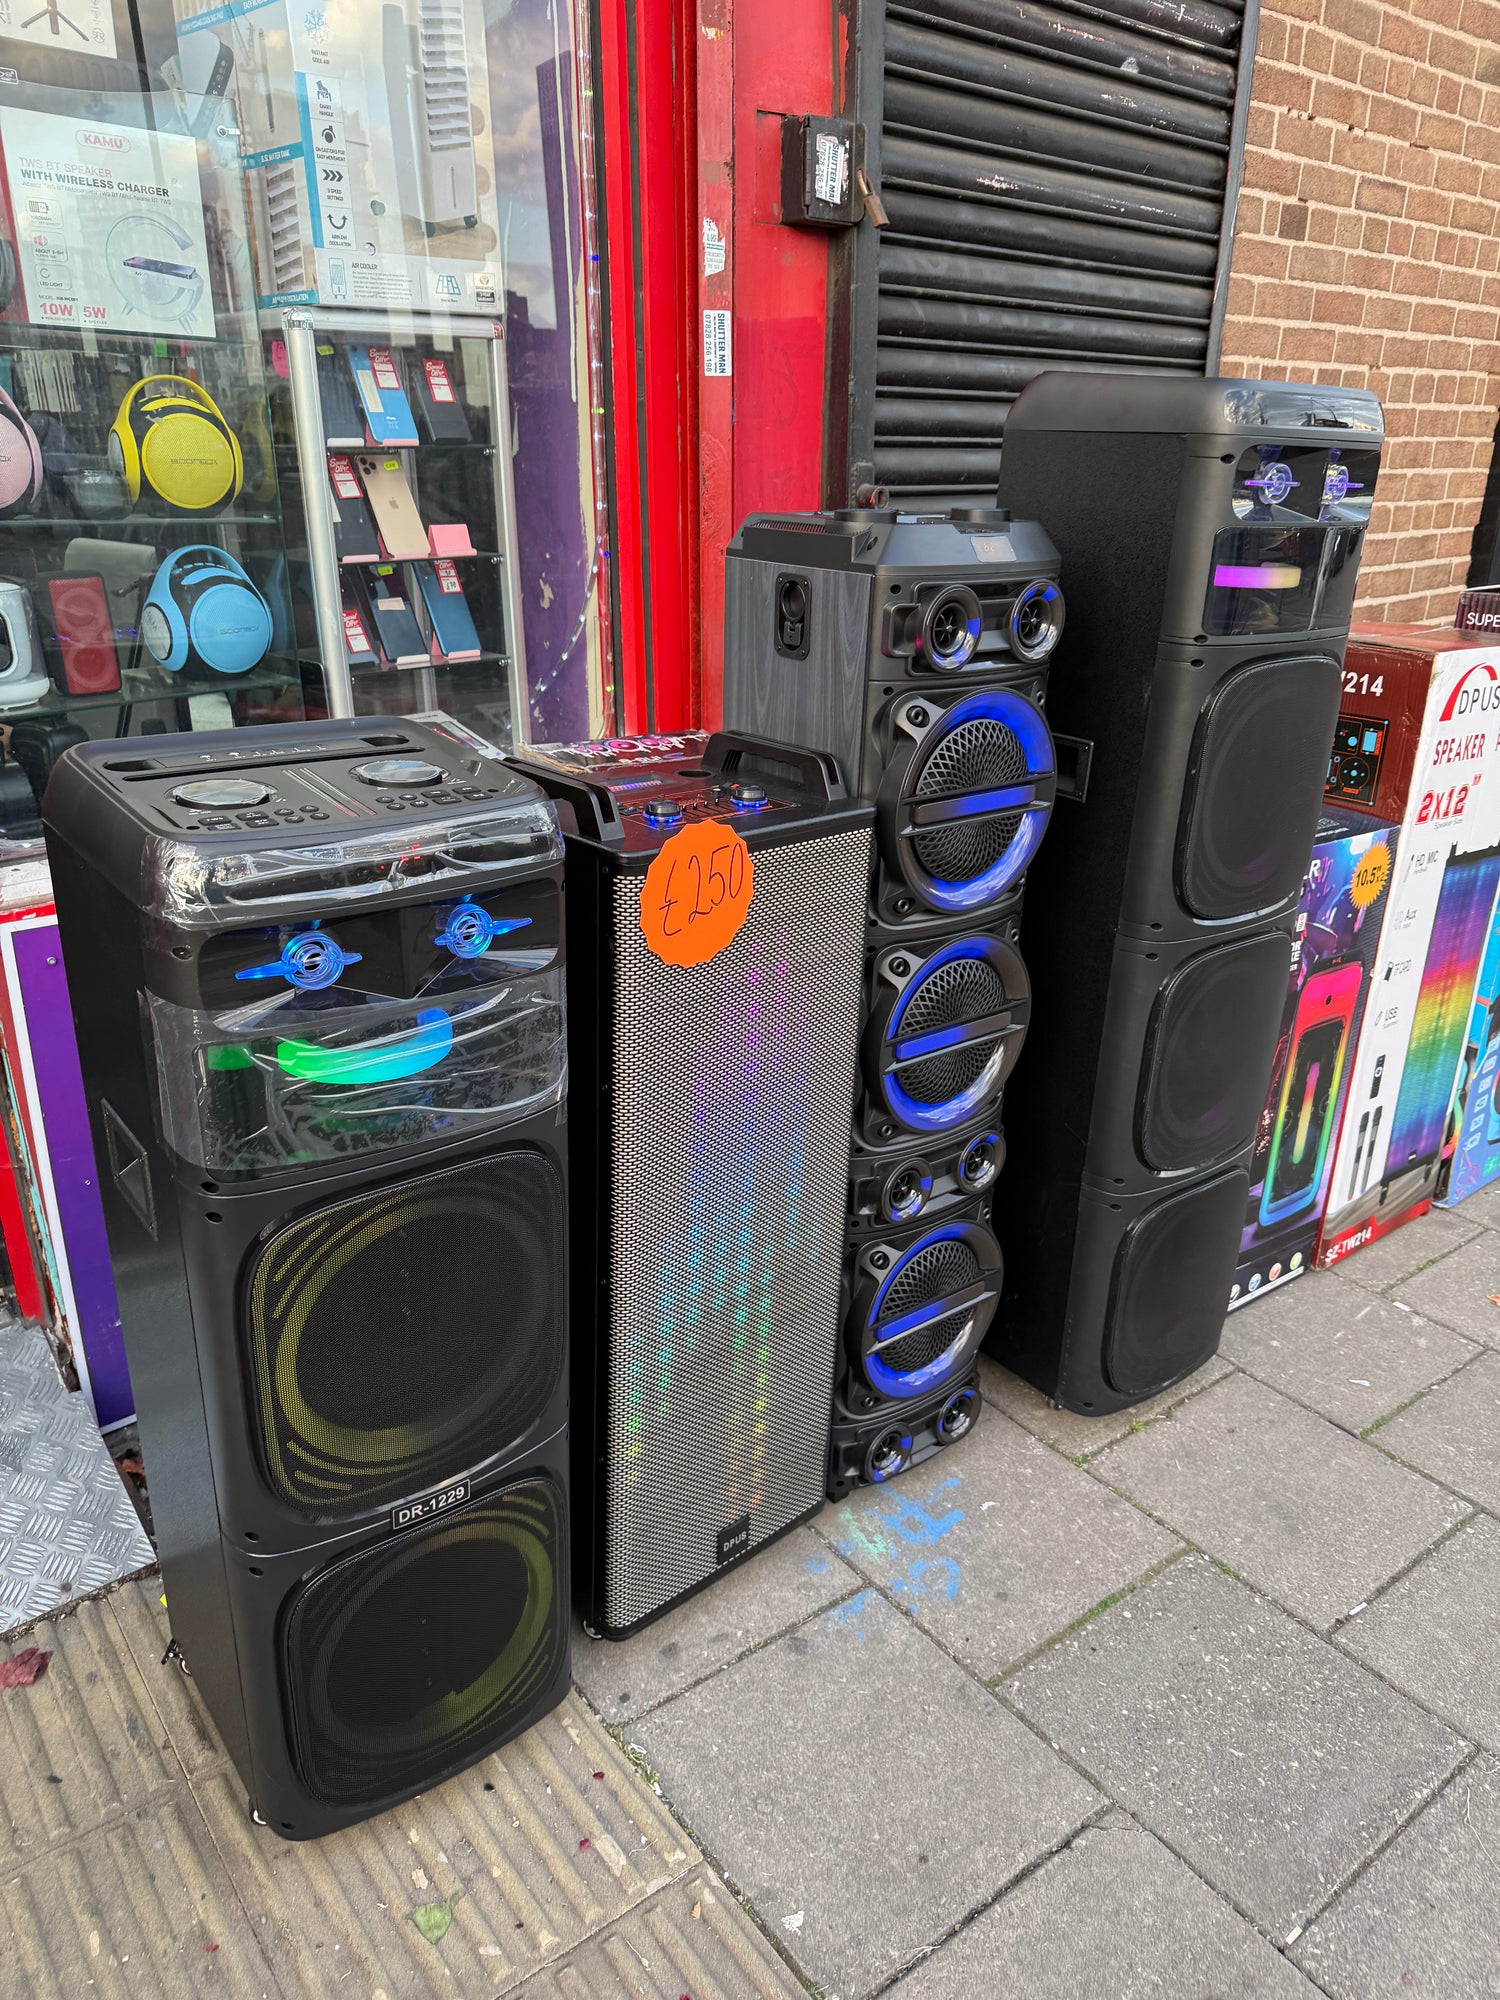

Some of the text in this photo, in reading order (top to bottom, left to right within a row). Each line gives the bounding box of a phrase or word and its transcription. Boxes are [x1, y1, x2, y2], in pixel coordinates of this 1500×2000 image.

[83, 133, 124, 149] KAMU
[819, 141, 827, 166] 07828
[19, 157, 112, 178] TWS BT SPEAKER
[829, 143, 839, 183] SHUTTER
[20, 169, 52, 181] WITH
[55, 173, 114, 189] WIRELESS
[117, 182, 170, 197] CHARGER
[40, 302, 73, 316] 10W
[83, 306, 106, 319] 5W
[717, 313, 727, 374] SHUTTER MAN
[1458, 686, 1500, 715] DPUS
[1433, 734, 1486, 766] SPEAKER
[1414, 850, 1439, 868] HD MIC
[659, 842, 745, 937] £250
[1404, 908, 1418, 923] Aux
[1385, 1006, 1398, 1021] USB
[1324, 1226, 1373, 1263] SZ-TW214
[398, 1486, 465, 1523] DR-1229
[723, 1530, 747, 1552] DPUS
